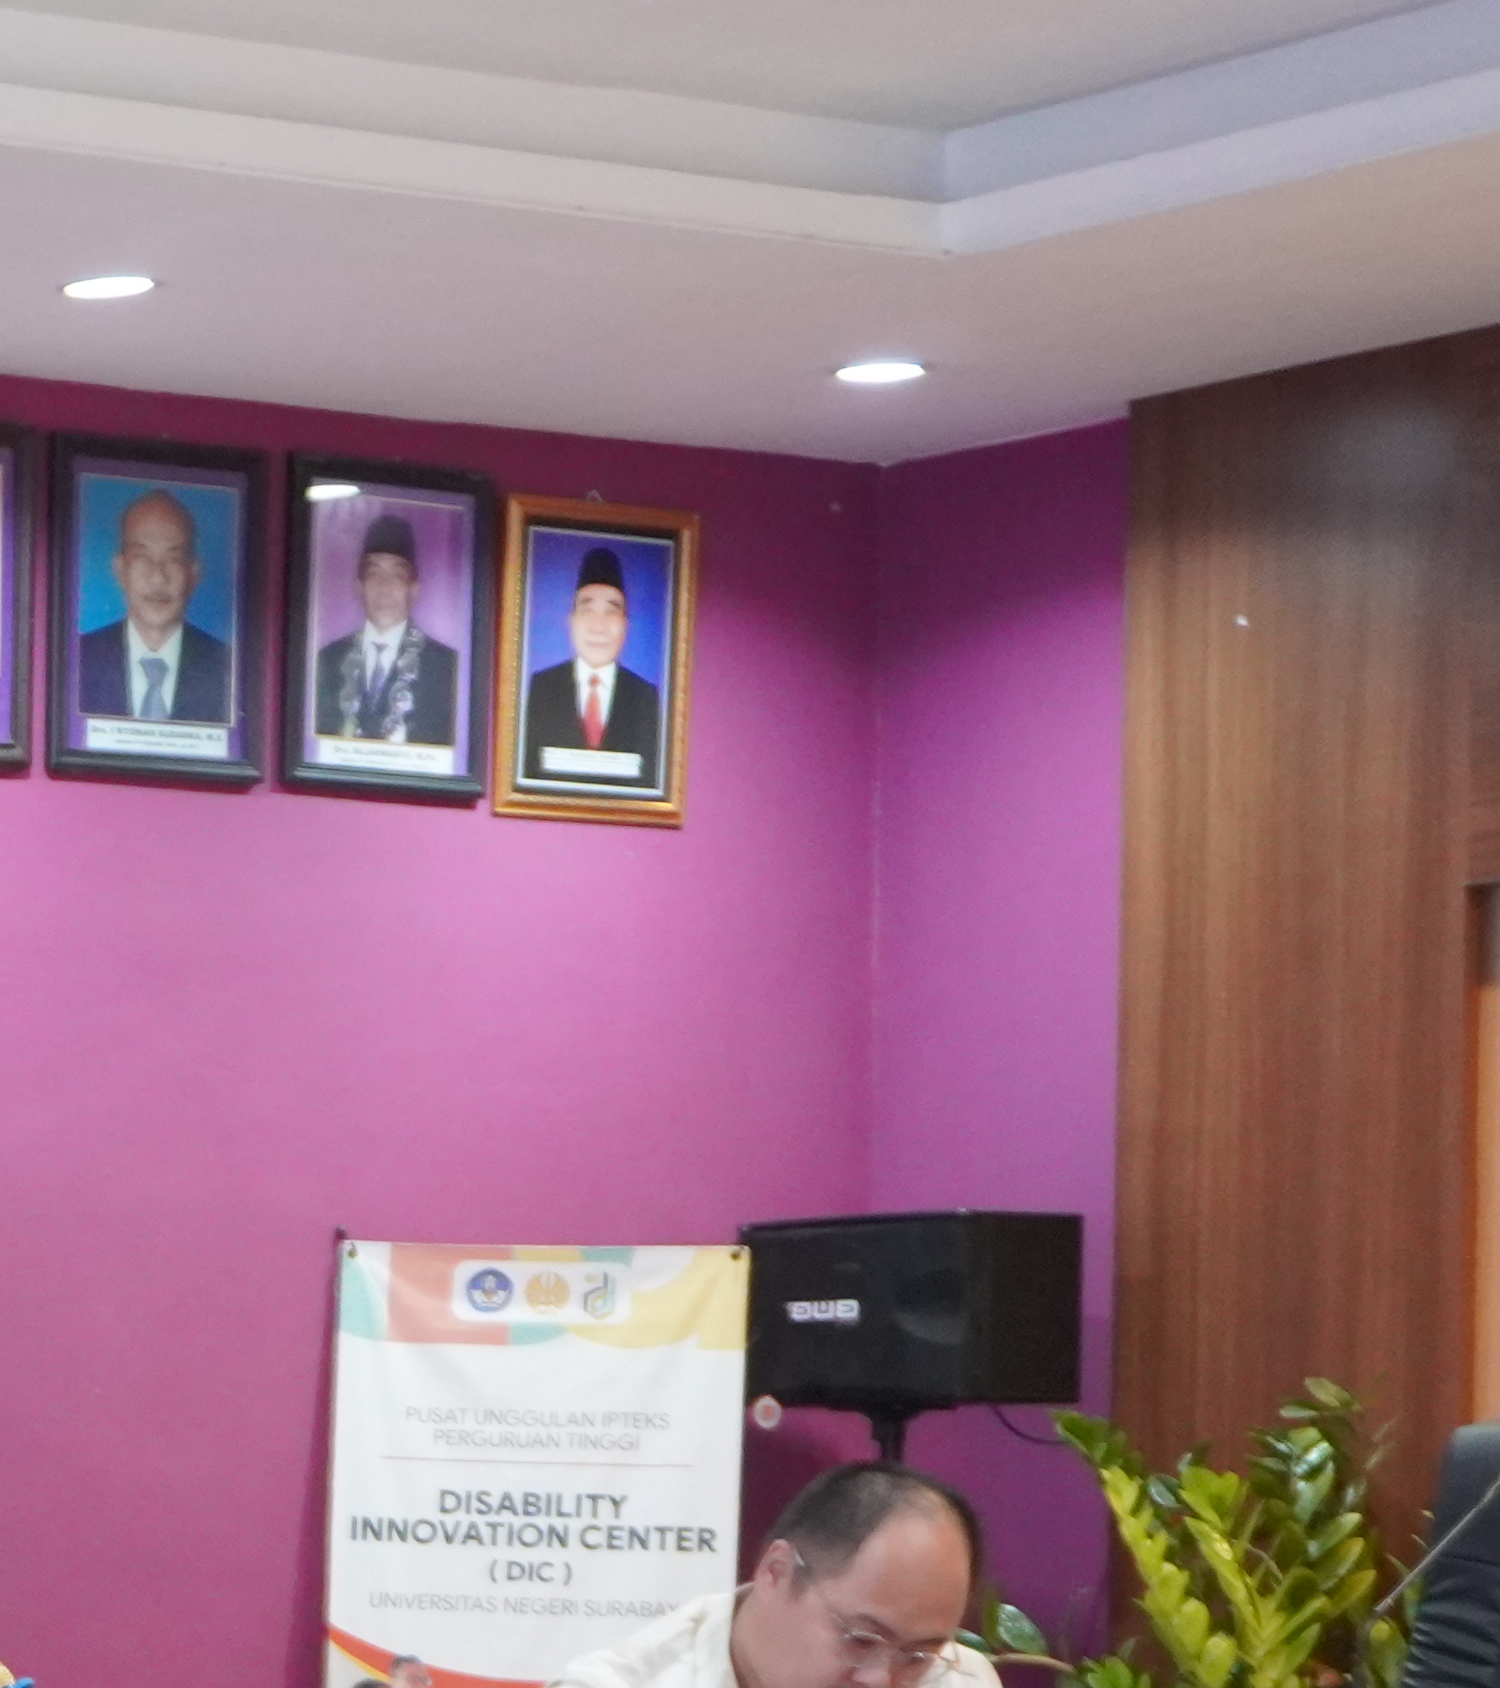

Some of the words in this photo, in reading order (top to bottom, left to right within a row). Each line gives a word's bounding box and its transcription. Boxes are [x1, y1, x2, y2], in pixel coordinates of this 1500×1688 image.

[405, 1406, 468, 1425] PUSAT
[475, 1409, 595, 1428] UNGGULAN
[602, 1412, 671, 1430] IPTEKS
[433, 1430, 560, 1449] PERGURUAN
[568, 1433, 641, 1451] TINGGI
[439, 1489, 628, 1520] DISABILITY
[350, 1517, 569, 1549] INNOVATION
[580, 1525, 718, 1553] CENTER
[369, 1592, 498, 1613] UNIVERSITAS
[504, 1598, 578, 1615] NEGERI
[584, 1600, 680, 1618] SURABAY
